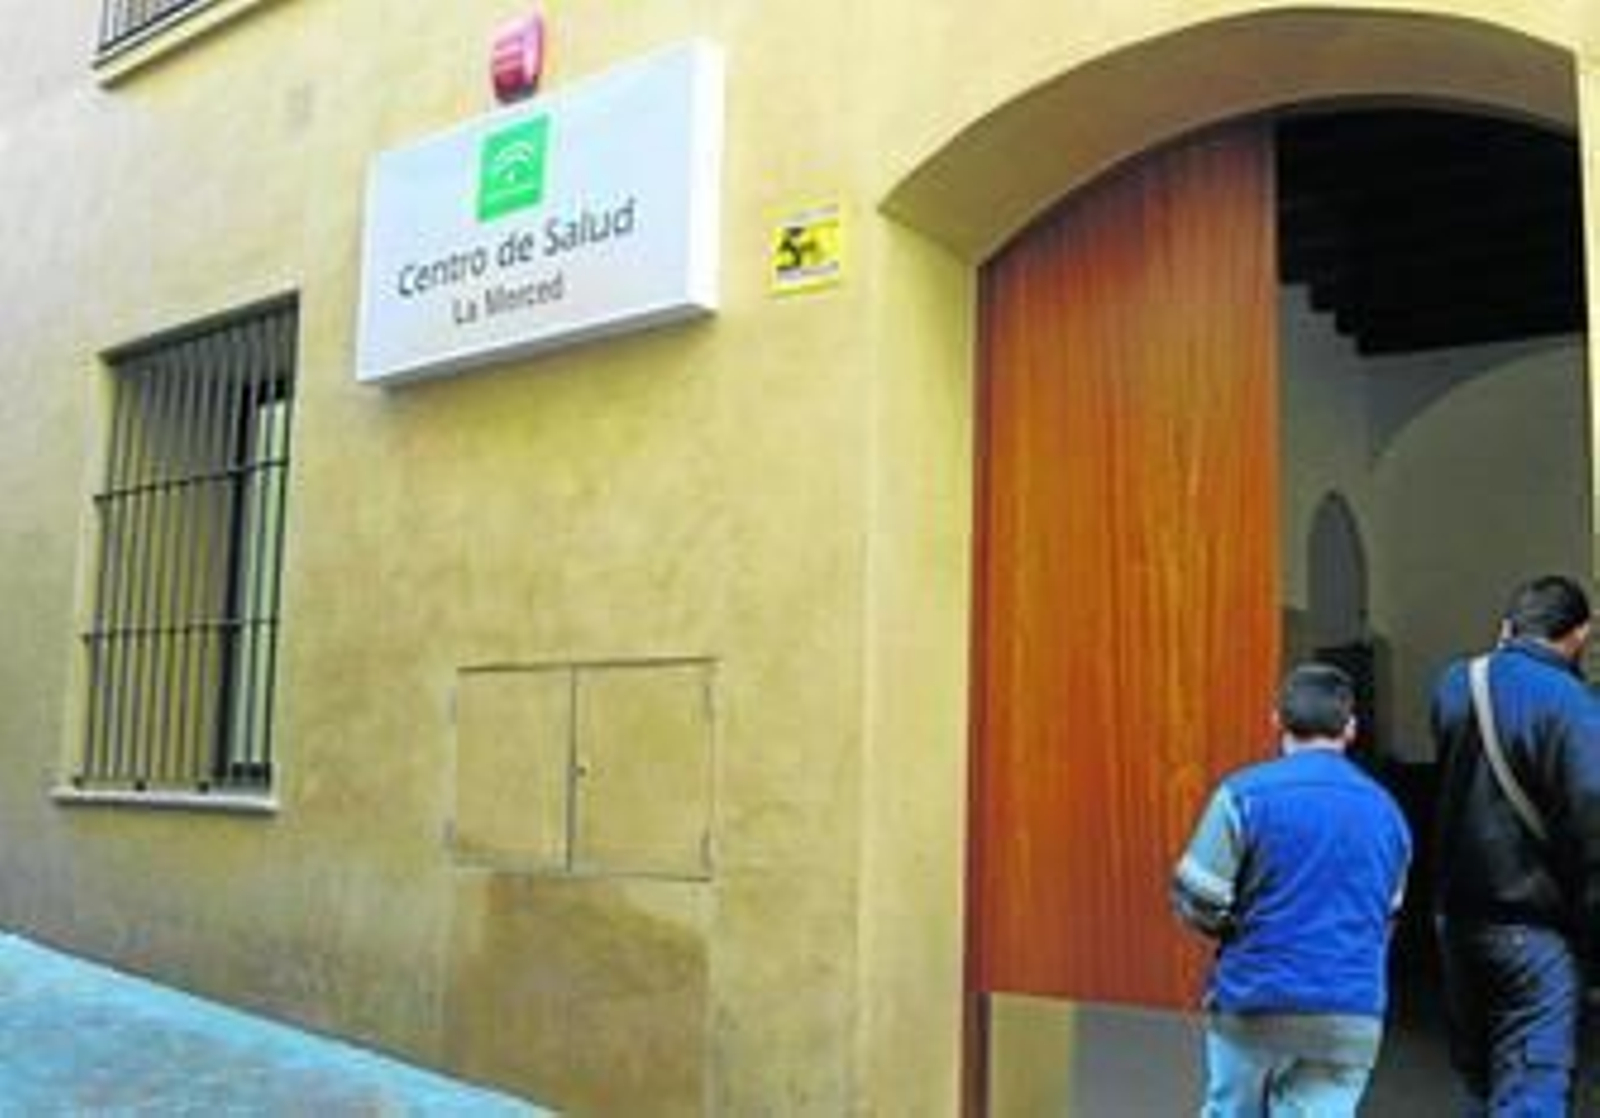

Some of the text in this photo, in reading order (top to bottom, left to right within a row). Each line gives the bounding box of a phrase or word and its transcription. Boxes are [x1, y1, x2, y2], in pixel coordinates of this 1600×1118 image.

[398, 246, 488, 296] Centro
[498, 231, 534, 266] de
[544, 195, 636, 256] Salud
[453, 270, 563, 325] La Merced
